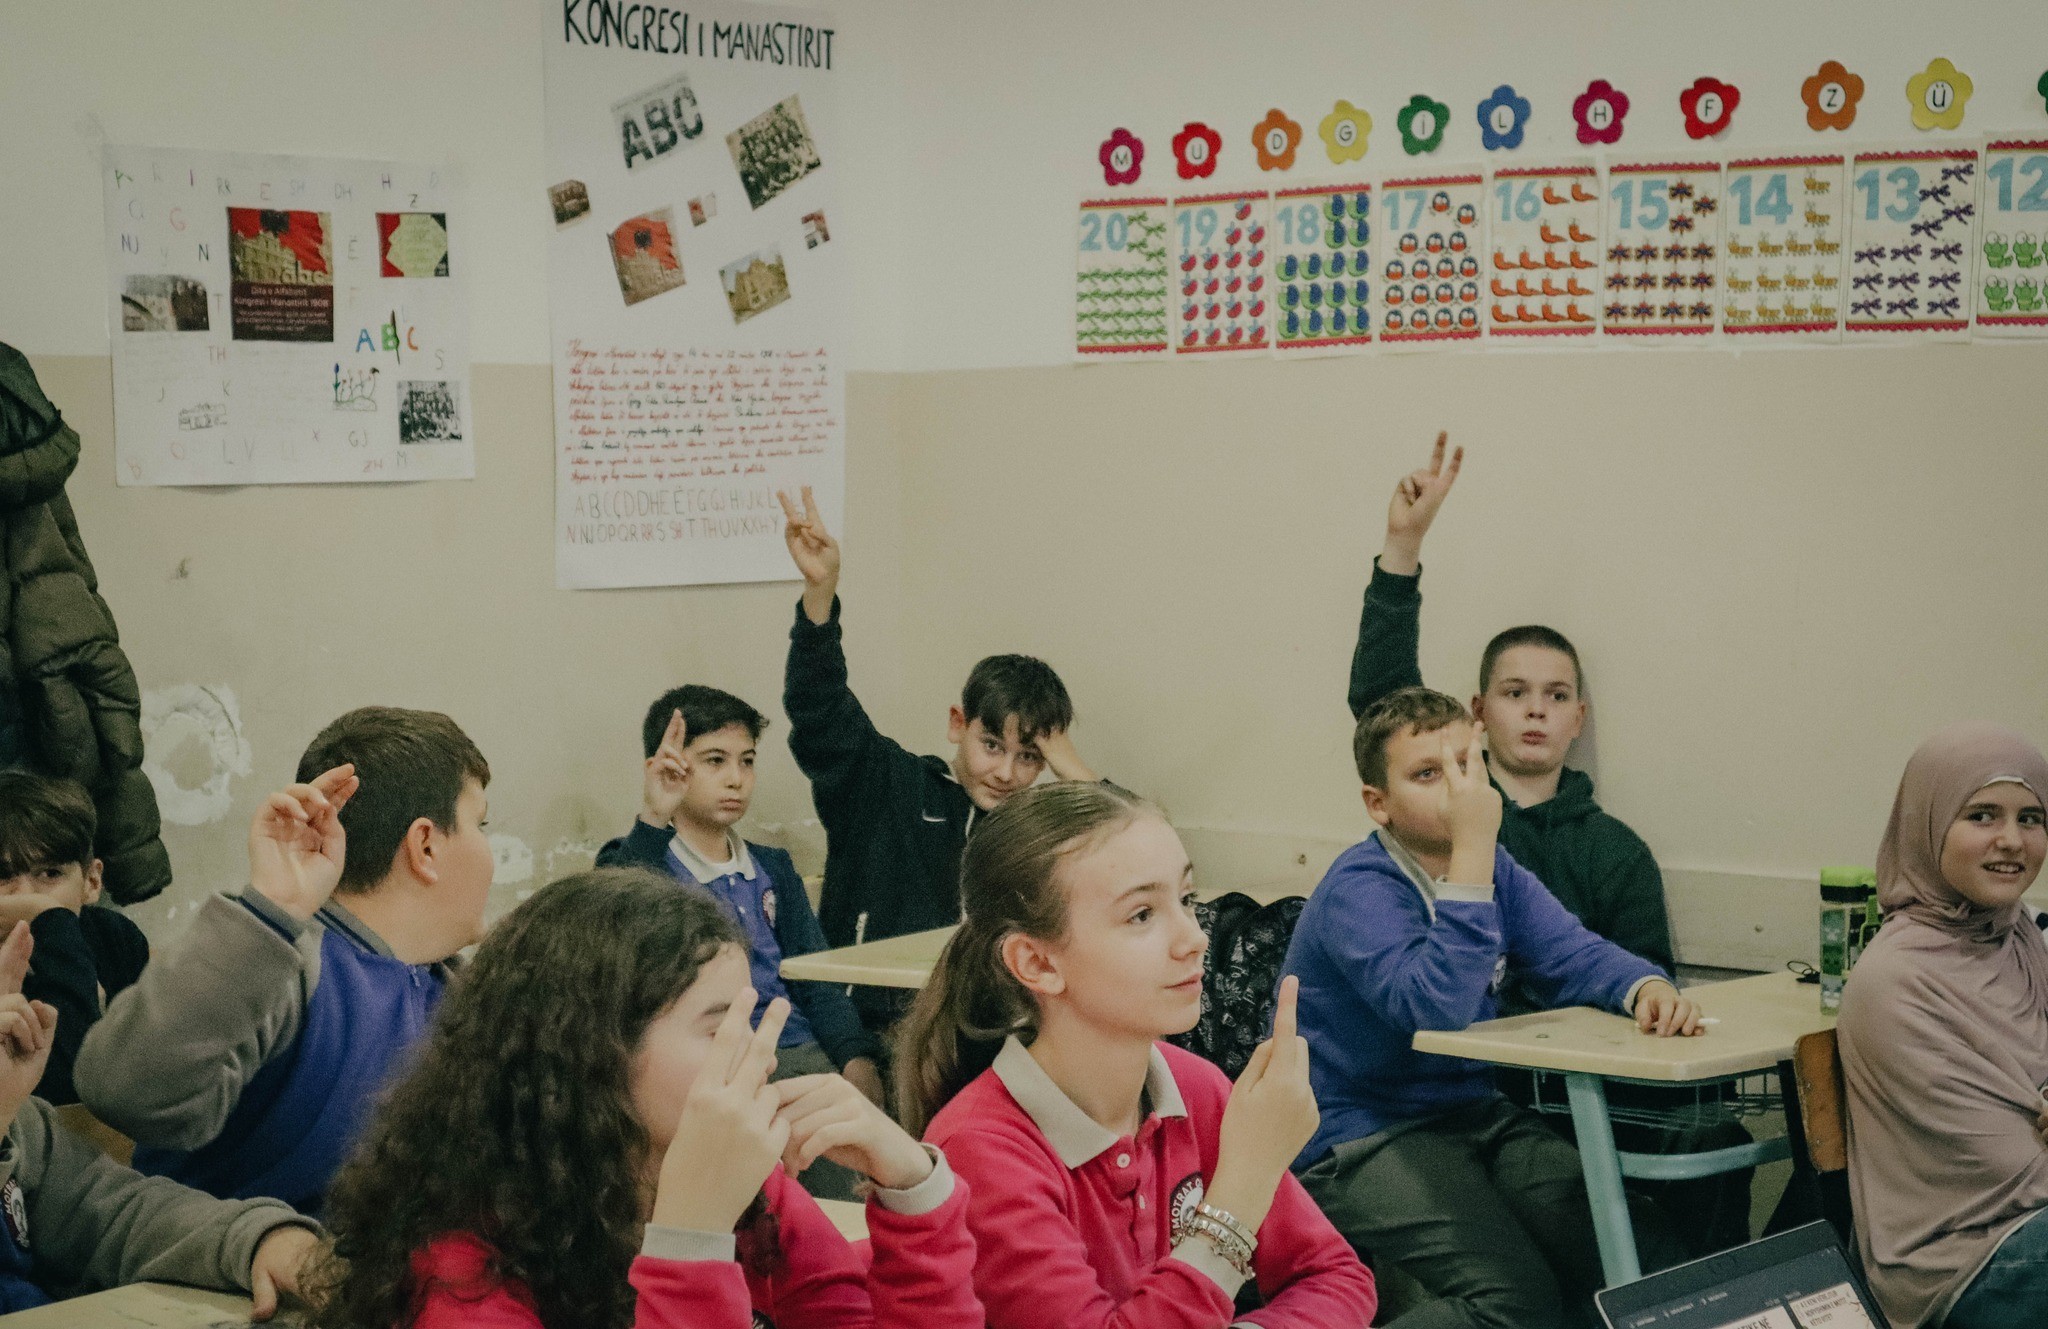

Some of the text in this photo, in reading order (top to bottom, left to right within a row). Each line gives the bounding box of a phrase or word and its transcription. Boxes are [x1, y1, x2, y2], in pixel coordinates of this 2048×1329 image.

[564, 0, 689, 54] KONGRESI
[713, 21, 834, 69] MANASTIRIT
[1704, 99, 1715, 117] F
[1826, 88, 1838, 108] Z
[1932, 83, 1946, 108] Ü
[622, 87, 704, 168] ABC
[1499, 112, 1507, 129] L
[1593, 106, 1607, 122] H
[1272, 134, 1283, 150] D
[1340, 125, 1352, 141] G
[1115, 152, 1128, 165] M
[1192, 145, 1203, 159] U
[1728, 174, 1793, 225] 14
[1855, 166, 1921, 223] 13
[1987, 155, 2048, 212] 12
[1382, 190, 1428, 230] 17
[1496, 180, 1542, 222] 16
[1611, 179, 1670, 231] 15
[1080, 212, 1128, 251] 20
[1176, 207, 1218, 248] 19
[1277, 203, 1320, 245] 18
[198, 243, 210, 261] N
[356, 323, 418, 352] A B C
